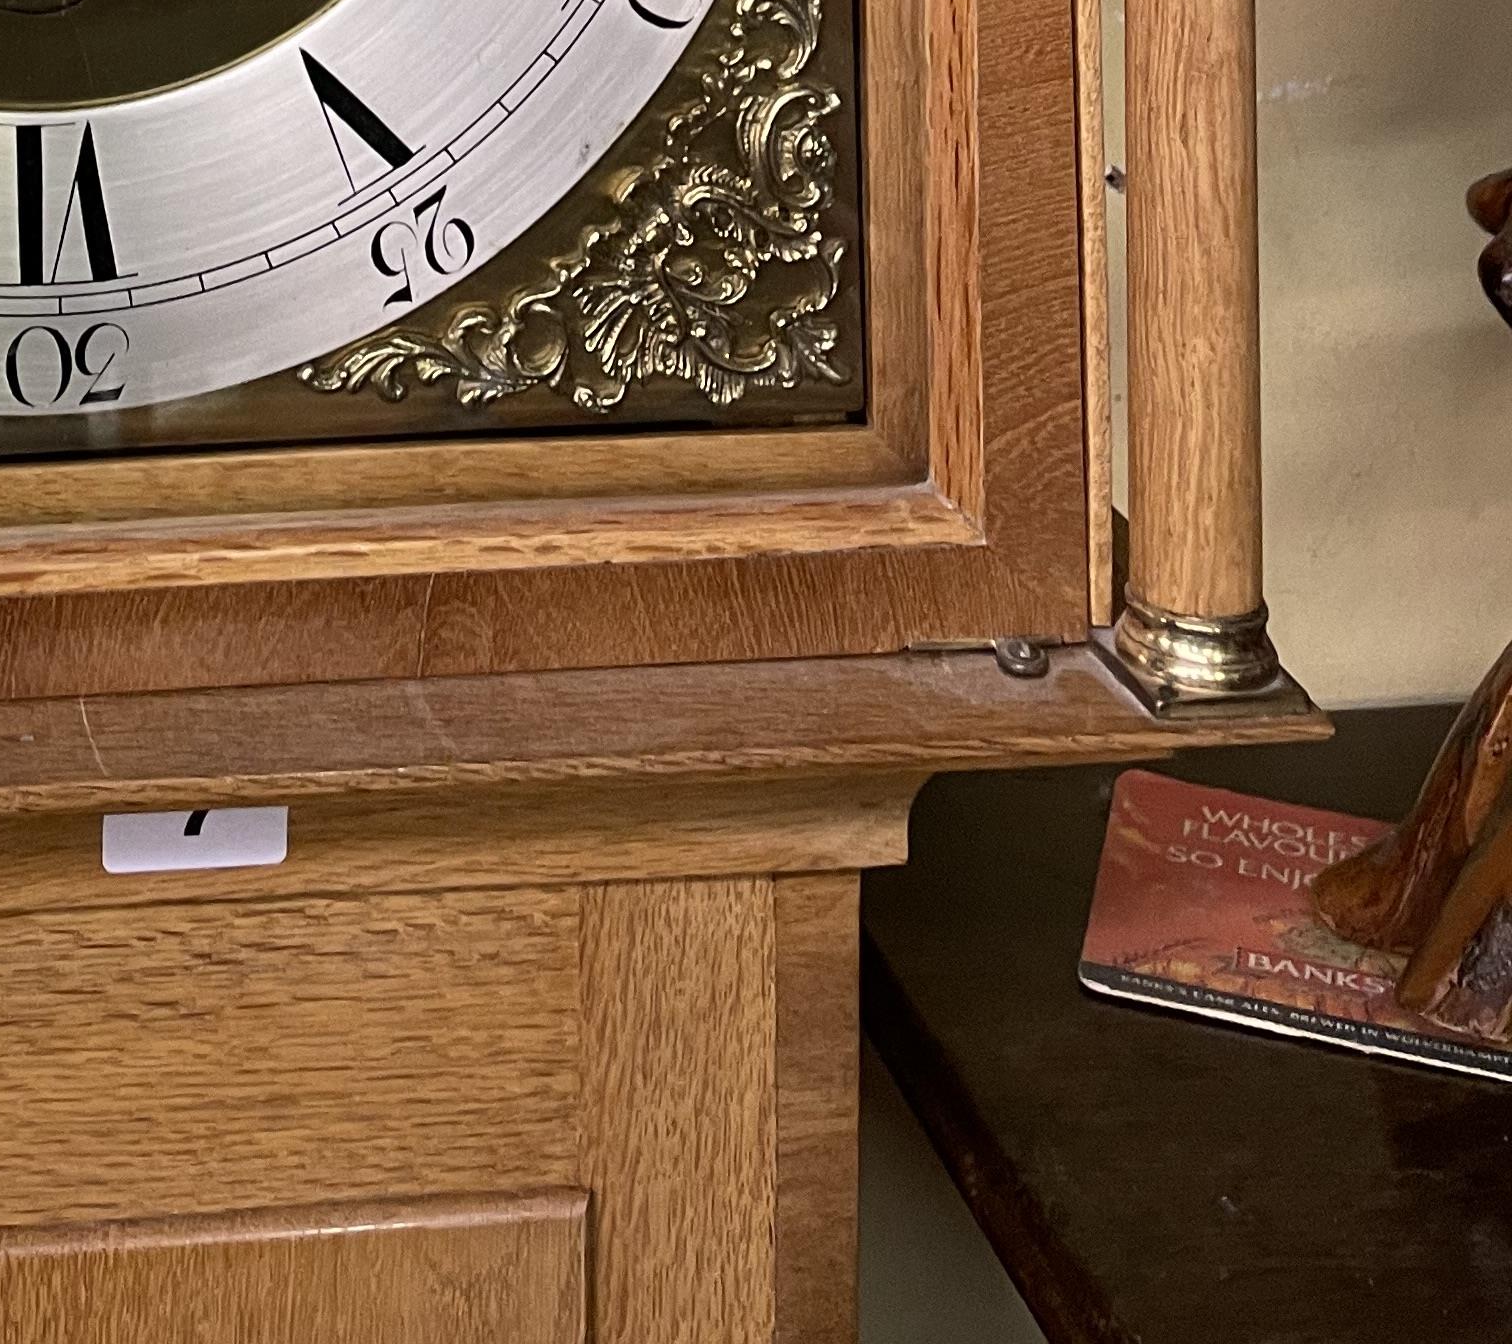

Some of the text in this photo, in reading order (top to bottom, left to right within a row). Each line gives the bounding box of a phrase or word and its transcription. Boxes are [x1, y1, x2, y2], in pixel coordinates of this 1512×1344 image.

[299, 47, 427, 206] V
[370, 184, 476, 311] 25
[5, 322, 130, 408] 30
[1166, 845, 1224, 869] SO
